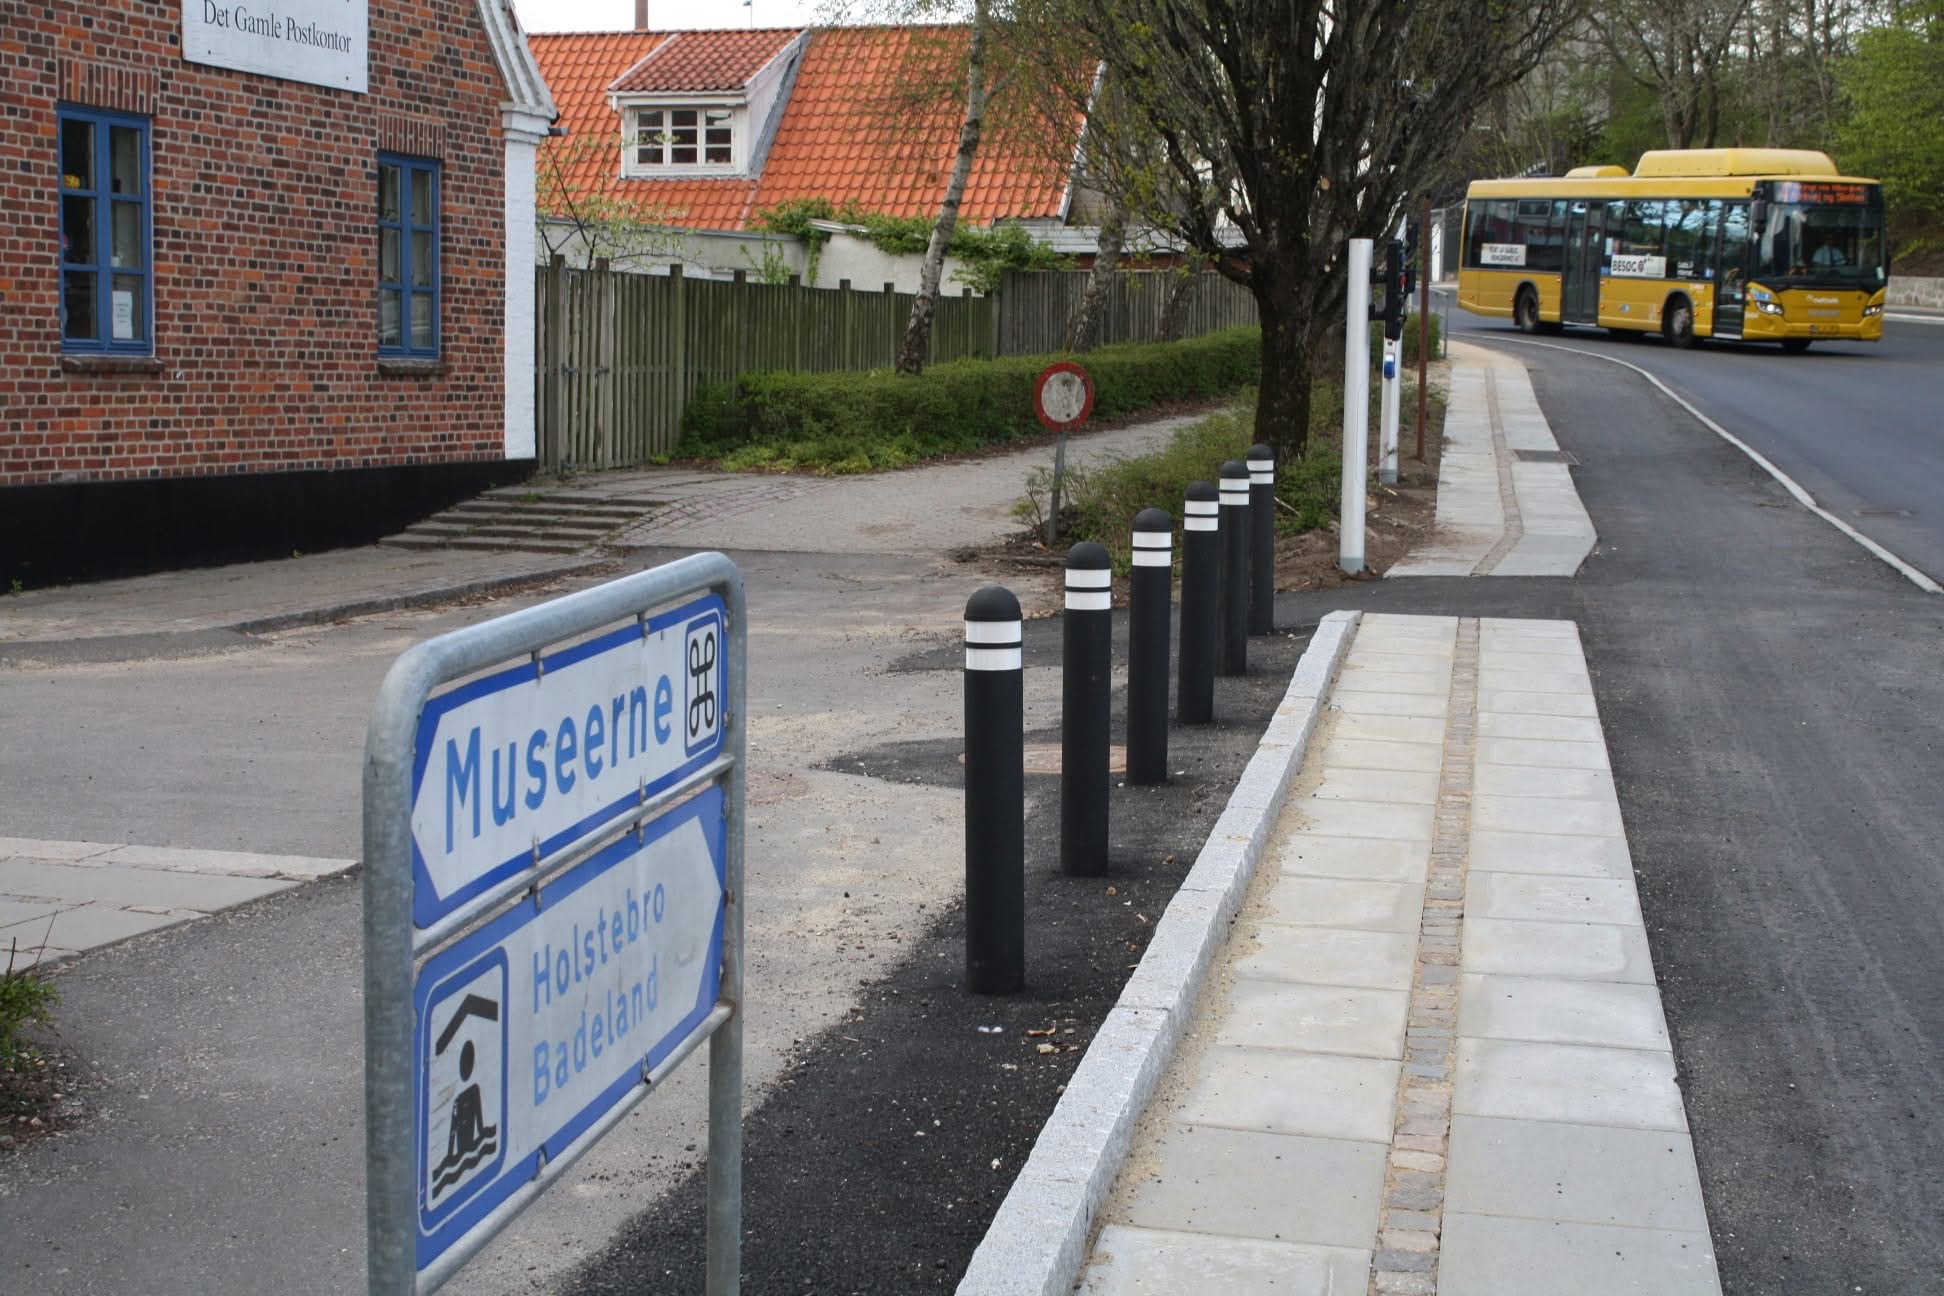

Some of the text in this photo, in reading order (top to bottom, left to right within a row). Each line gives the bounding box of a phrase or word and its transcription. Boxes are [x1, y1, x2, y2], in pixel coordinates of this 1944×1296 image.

[203, 0, 351, 53] Det Gamle Postkontor
[446, 674, 673, 855] Museerne
[533, 882, 665, 1015] Holstebro
[534, 954, 658, 1107] Badeland
